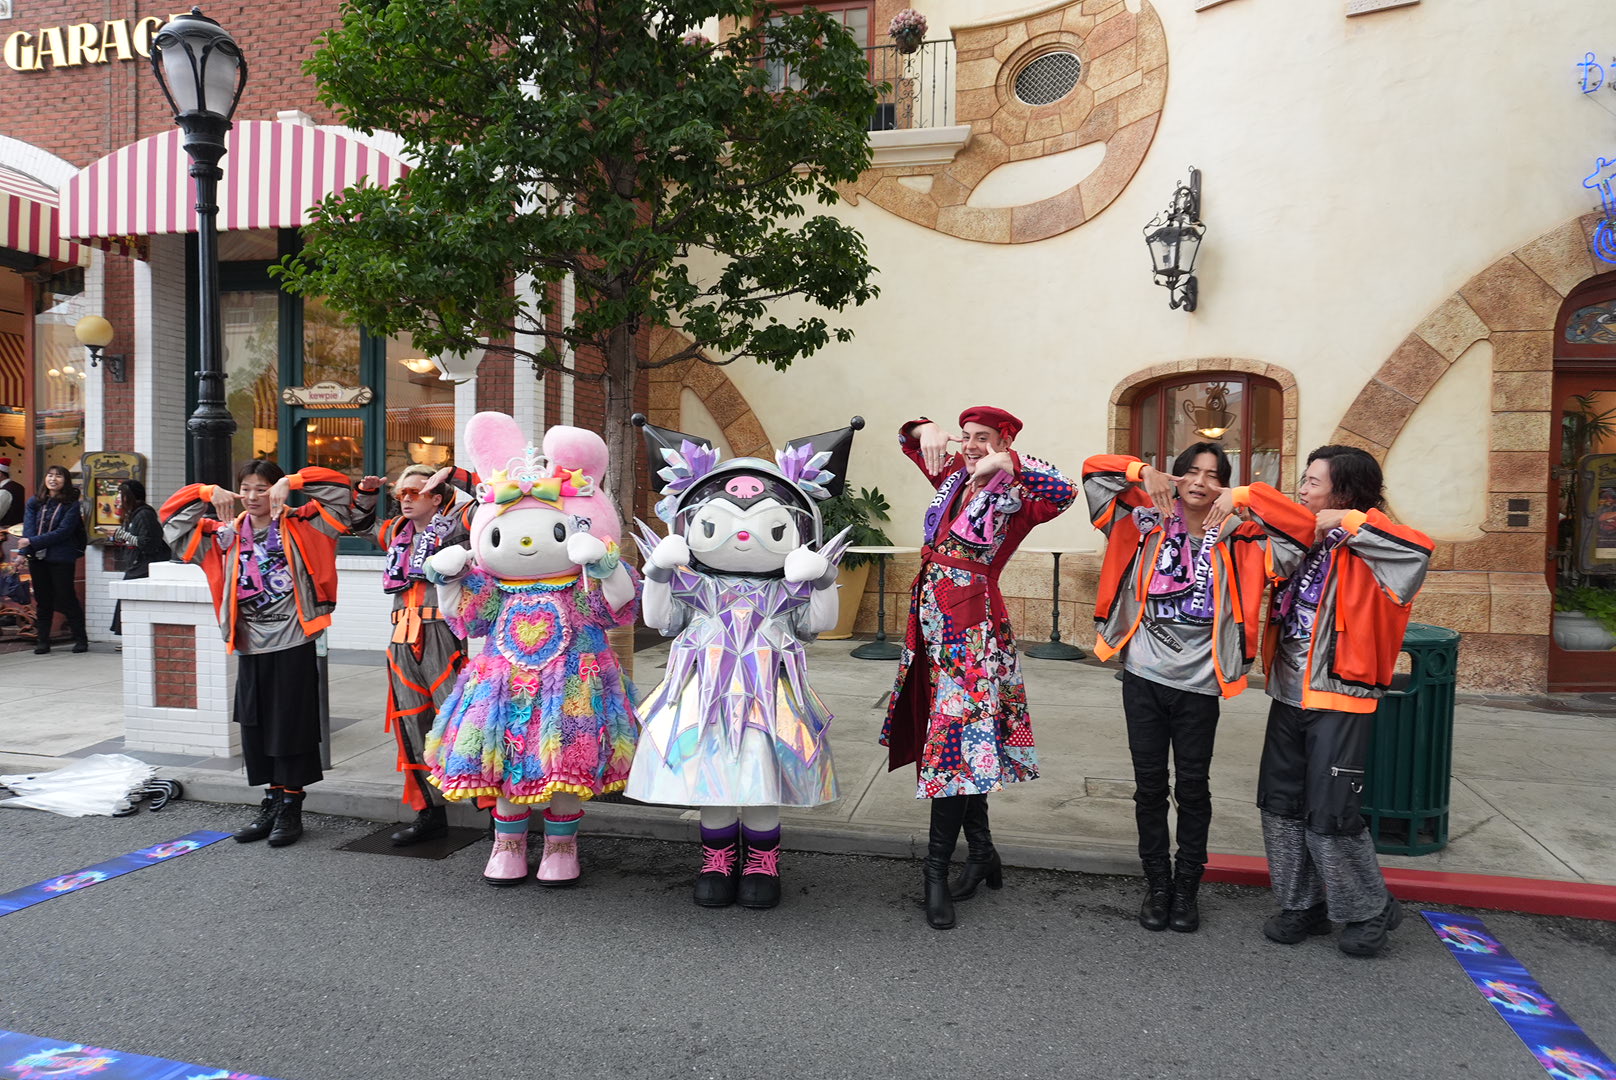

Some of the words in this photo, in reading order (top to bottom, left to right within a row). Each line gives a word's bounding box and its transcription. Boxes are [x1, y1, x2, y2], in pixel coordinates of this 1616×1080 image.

[3, 13, 192, 71] GARAG
[309, 390, 338, 400] kewpie
[412, 530, 431, 568] BLACK
